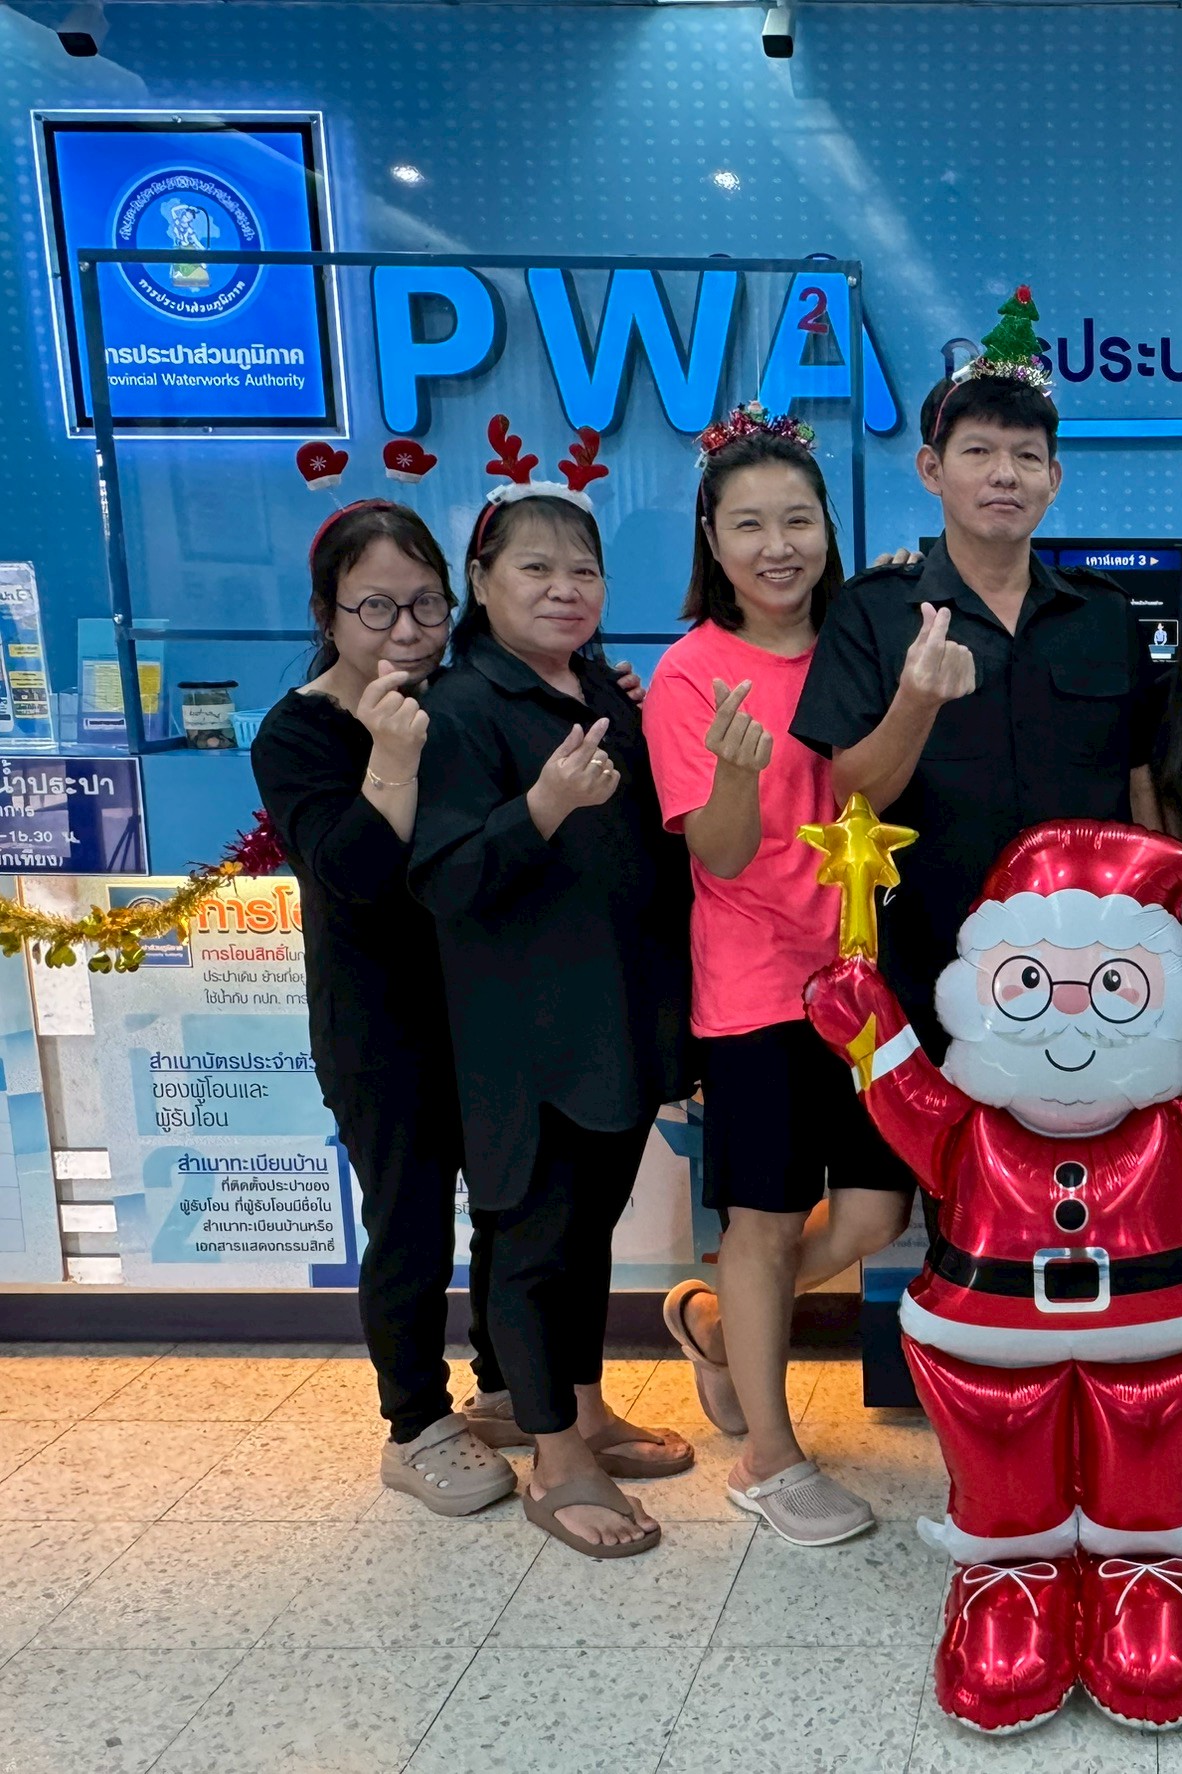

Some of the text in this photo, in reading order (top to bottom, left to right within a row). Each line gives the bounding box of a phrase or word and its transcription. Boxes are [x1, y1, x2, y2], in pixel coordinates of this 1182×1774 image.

[797, 287, 829, 334] 2
[370, 254, 900, 434] PWA
[105, 343, 305, 370] ารประปาส่วนภูมิภาค
[108, 373, 305, 390] rovincial Waterworks Authority
[1138, 555, 1147, 566] 3
[152, 1075, 269, 1104] ของผู้โอนและ
[155, 1105, 229, 1133] ผู้รับโอน
[177, 1153, 328, 1174] สำเนาทะเบียนบ้าน
[221, 1176, 330, 1192] ที่ติดตั้งประปาของ
[179, 1197, 230, 1215] ผู้รับโอน
[203, 1218, 334, 1232] สำเนาทะเบียนบ้านหรือ
